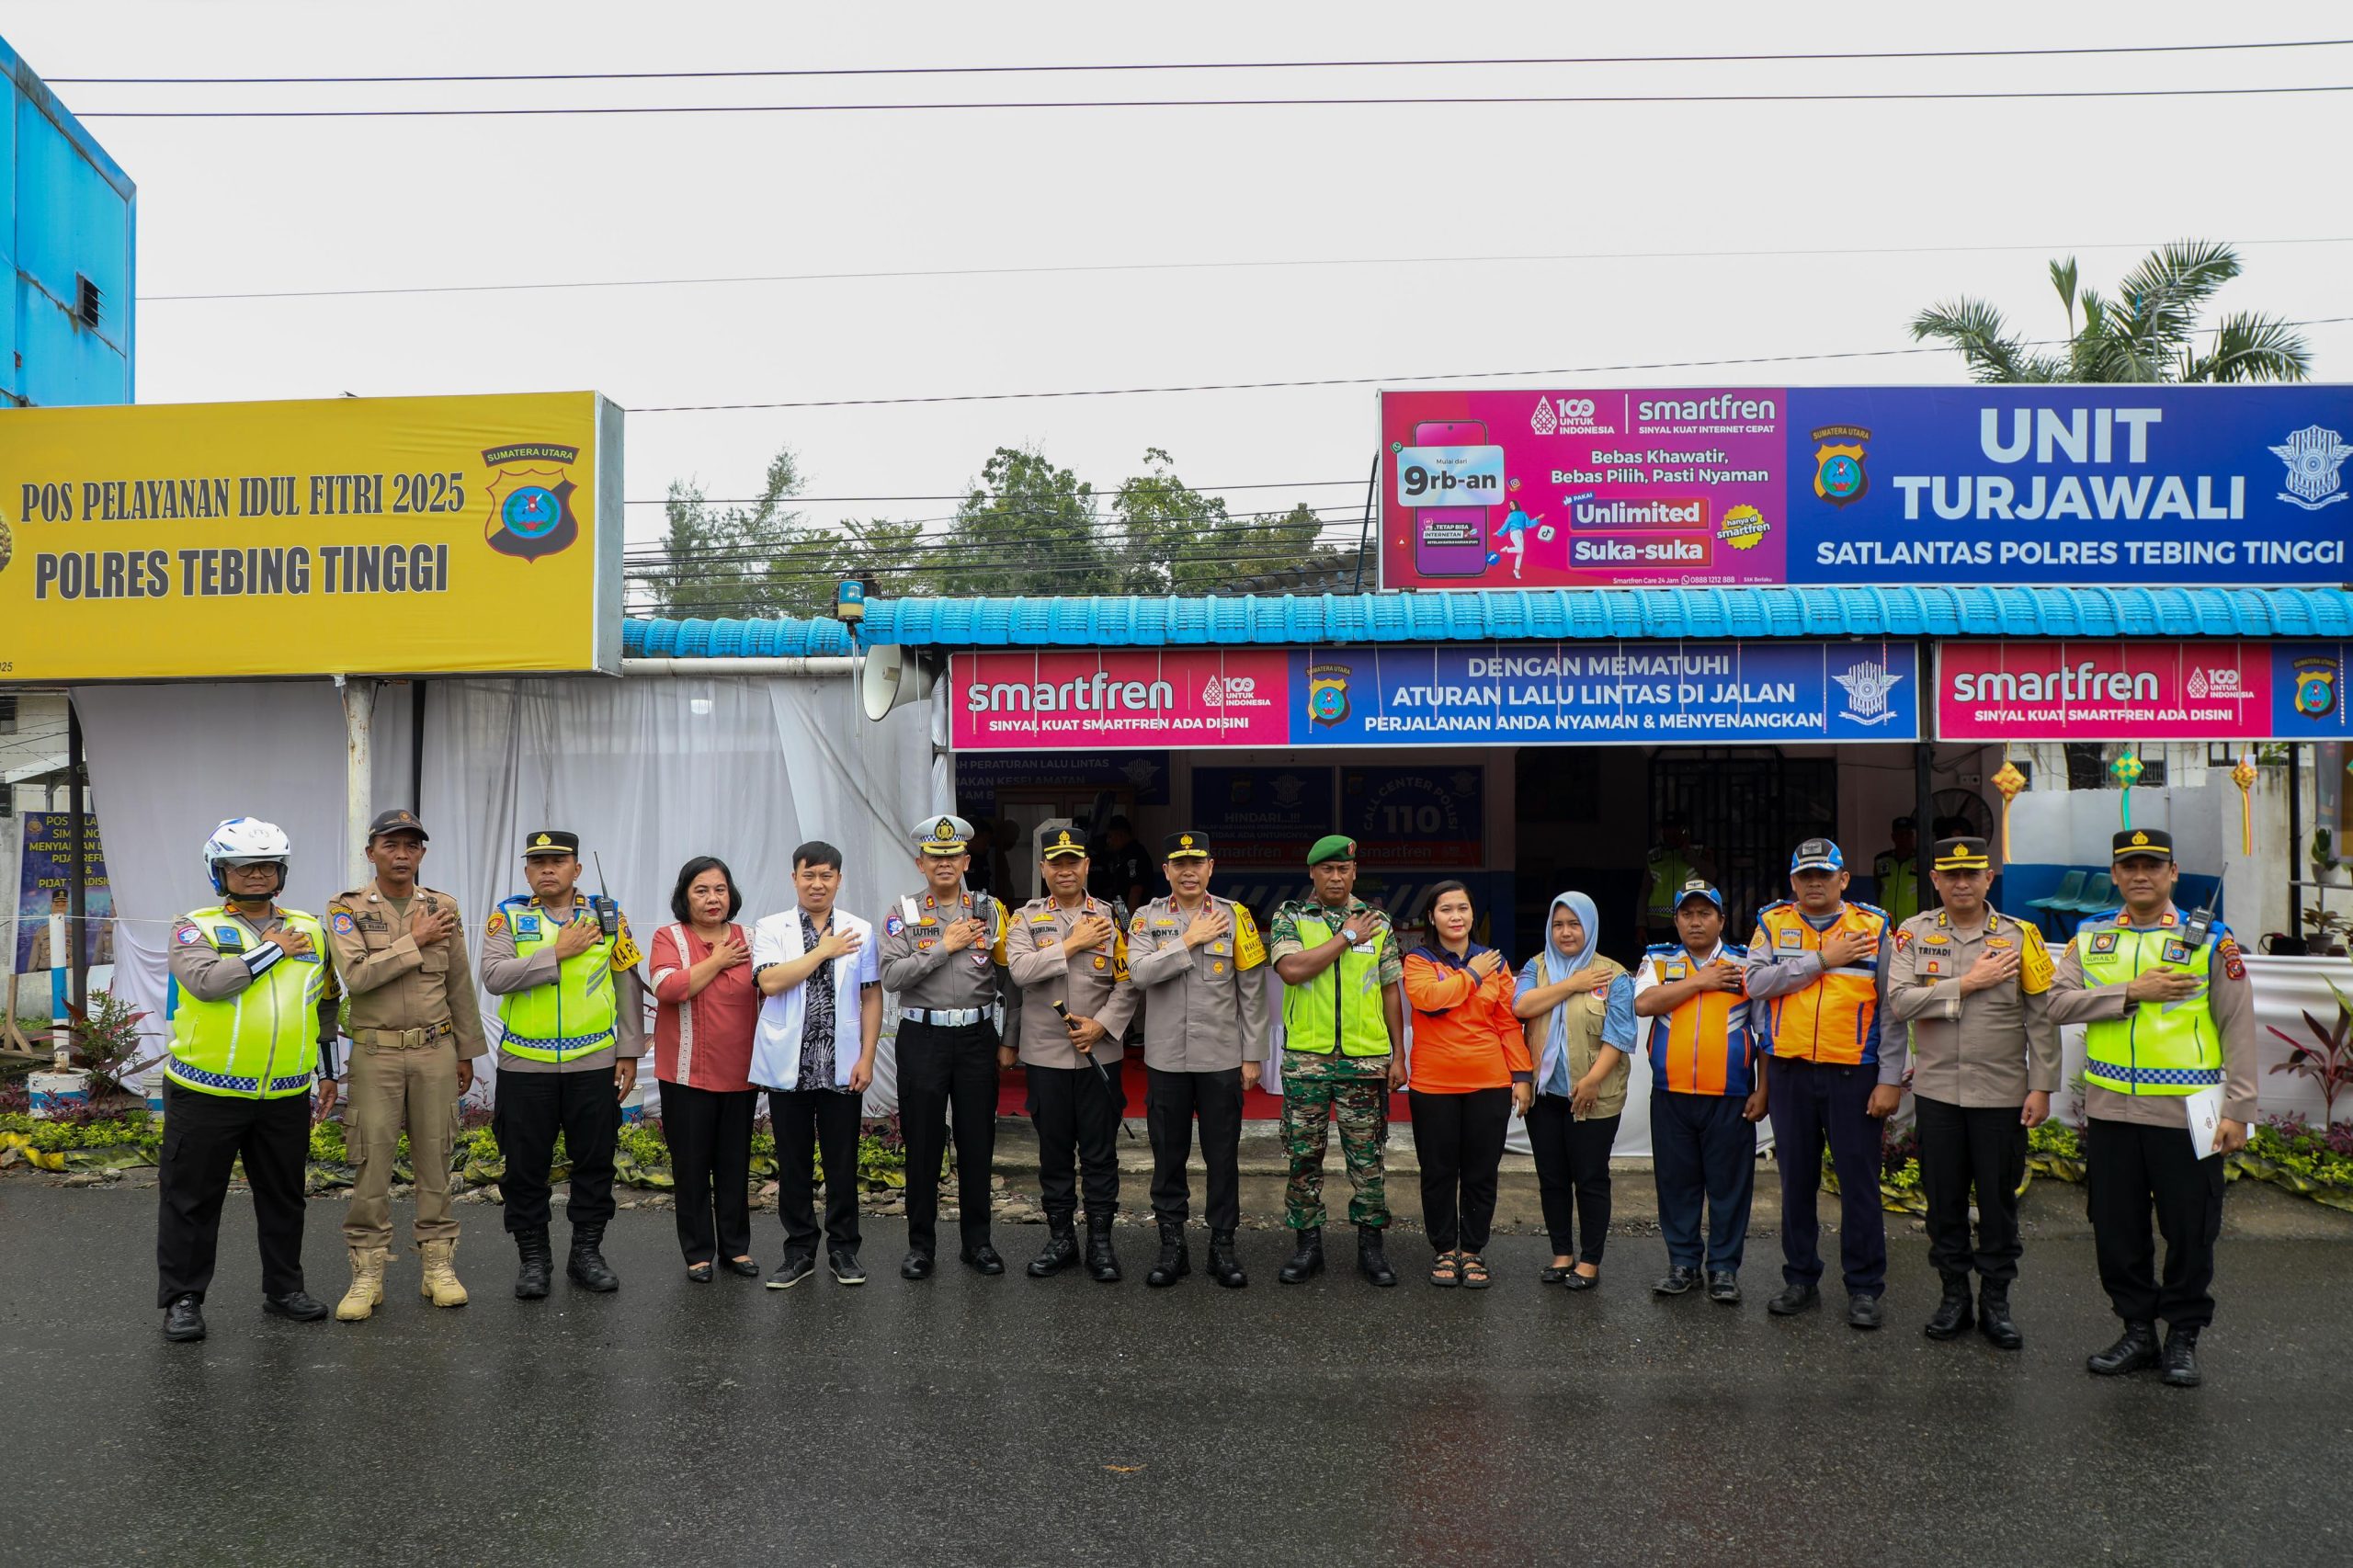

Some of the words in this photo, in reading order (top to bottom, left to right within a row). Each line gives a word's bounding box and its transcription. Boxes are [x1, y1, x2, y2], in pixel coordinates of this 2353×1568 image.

[1638, 393, 1776, 421] smartfren
[1559, 417, 1595, 426] UNTUK
[1559, 426, 1616, 435] INDONESIA
[1639, 426, 1672, 435] SINYAL
[1673, 426, 1698, 434] KUAT
[1699, 426, 1745, 434] INTERNET
[1745, 425, 1775, 433] CEPAT
[1813, 426, 1847, 440] SUMATERA
[1847, 427, 1869, 439] UTARA
[1980, 407, 2162, 464] UNIT
[486, 448, 540, 462] SUMATERA
[541, 448, 574, 460] UTARA
[1591, 449, 1643, 464] Bebas
[1647, 448, 1729, 465] Khawatir,
[1404, 466, 1497, 496] 9rb-an
[1551, 470, 1603, 484] Bebas
[1607, 468, 1649, 485] Pilih,
[1653, 468, 1695, 483] Pasti
[1698, 469, 1768, 485] Nyaman
[20, 482, 74, 523] POS
[82, 476, 231, 522] PELAYANAN
[239, 474, 301, 517] IDUL
[309, 472, 383, 516] FITRI
[392, 472, 465, 514] 2025
[1573, 492, 1593, 502] PAKAI
[1893, 475, 2245, 521] TURJAWALI
[1576, 501, 1699, 524] Unlimited
[1726, 517, 1749, 527] hanya
[1749, 515, 1757, 523] di
[1716, 521, 1771, 540] smartfren
[1574, 539, 1704, 561] Suka-suka
[1816, 540, 1993, 564] SATLANTAS
[1999, 541, 2118, 564] POLRES
[2124, 540, 2234, 564] TEBING
[2242, 540, 2344, 563] TINGGI
[35, 549, 169, 600] POLRES
[178, 544, 310, 597] TEBING
[319, 542, 449, 595] TINGGI
[1722, 575, 1735, 584] 888
[0, 660, 13, 672] 25
[1467, 657, 1583, 678] DENGAN
[1587, 655, 1730, 676] MEMATUHI
[1953, 661, 2159, 702] smartfren
[967, 671, 1174, 712] smartfren
[1392, 685, 1503, 707] ATURAN
[1508, 685, 1573, 705] LALU
[1580, 684, 1671, 705] LINTAS
[1677, 684, 1704, 704] DI
[1708, 683, 1795, 703] JALAN
[1364, 716, 1492, 732] PERJALANAN
[1495, 715, 1551, 731] ANDA
[1555, 714, 1640, 730] NYAMAN
[1643, 714, 1655, 729] &
[1657, 712, 1824, 729] MENYENANGKAN
[1974, 710, 2026, 722] SINYAL
[2028, 710, 2066, 722] KUAT
[2068, 710, 2154, 722] SMARTFREN
[2156, 710, 2188, 721] ADA
[2190, 709, 2233, 721] DISINI
[989, 720, 1038, 732] SINYAL
[1040, 719, 1080, 731] KUAT
[1082, 718, 1170, 731] SMARTFREN
[1172, 718, 1204, 730] ADA
[1206, 717, 1249, 729] DISINI
[971, 759, 1038, 769] PERATURAN
[1040, 759, 1068, 768] LALU
[1071, 758, 1109, 767] LINTAS
[1363, 796, 1381, 831] CALL
[1379, 777, 1433, 796] CENTER
[1434, 787, 1459, 830] POLISI
[46, 816, 69, 826] POS
[1382, 805, 1442, 834] 110
[52, 854, 72, 863] PIJA
[84, 853, 105, 862] REFL
[1211, 844, 1282, 858] smartfren
[1360, 844, 1432, 858] smartfren
[85, 865, 93, 874] &
[38, 878, 67, 888] PIJAT
[1918, 946, 1951, 957] TRIYADI
